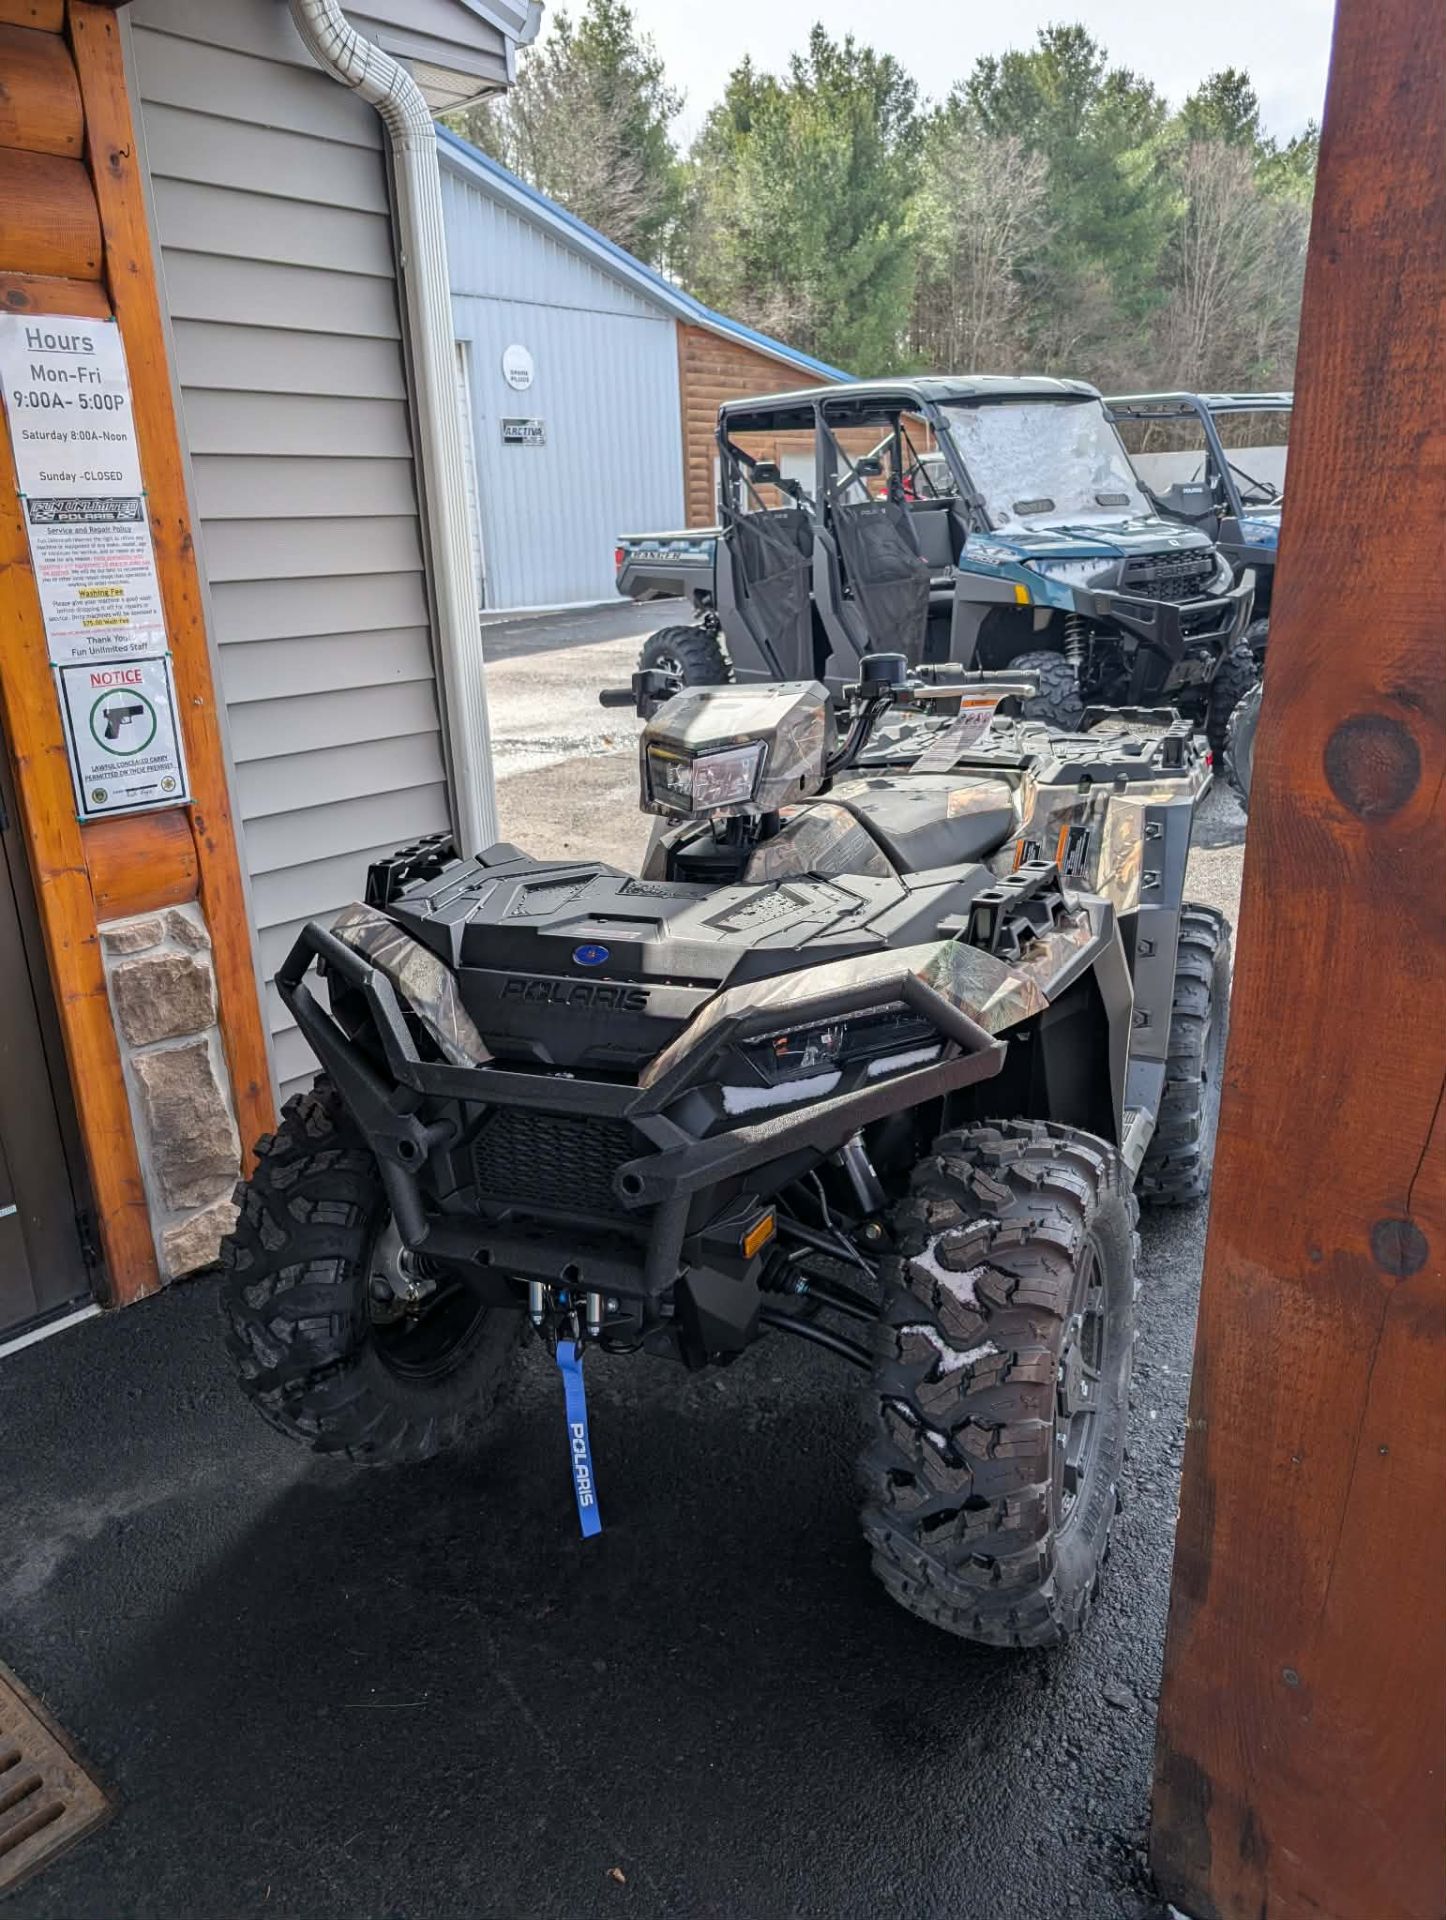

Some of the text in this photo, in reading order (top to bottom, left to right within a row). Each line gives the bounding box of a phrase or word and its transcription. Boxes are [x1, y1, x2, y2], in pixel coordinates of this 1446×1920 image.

[25, 328, 95, 352] Hours
[30, 364, 102, 383] Mon-Fri
[13, 391, 124, 410] 9:00A- 5:00P
[22, 430, 127, 442] Saturday 8:00A-Noon
[40, 471, 123, 482] Sunday -CLOSED
[47, 527, 73, 535] Service
[90, 526, 111, 534] Repair
[112, 525, 132, 533] Policy
[631, 551, 680, 560] RANGER
[79, 589, 109, 597] Washing
[87, 635, 111, 644] Thank
[72, 643, 148, 656] Fun Unlimited Staff
[90, 668, 143, 686] NOTICE
[150, 754, 168, 763] CARRY
[499, 979, 651, 1011] POLARIS
[570, 1423, 594, 1507] POLARIS
